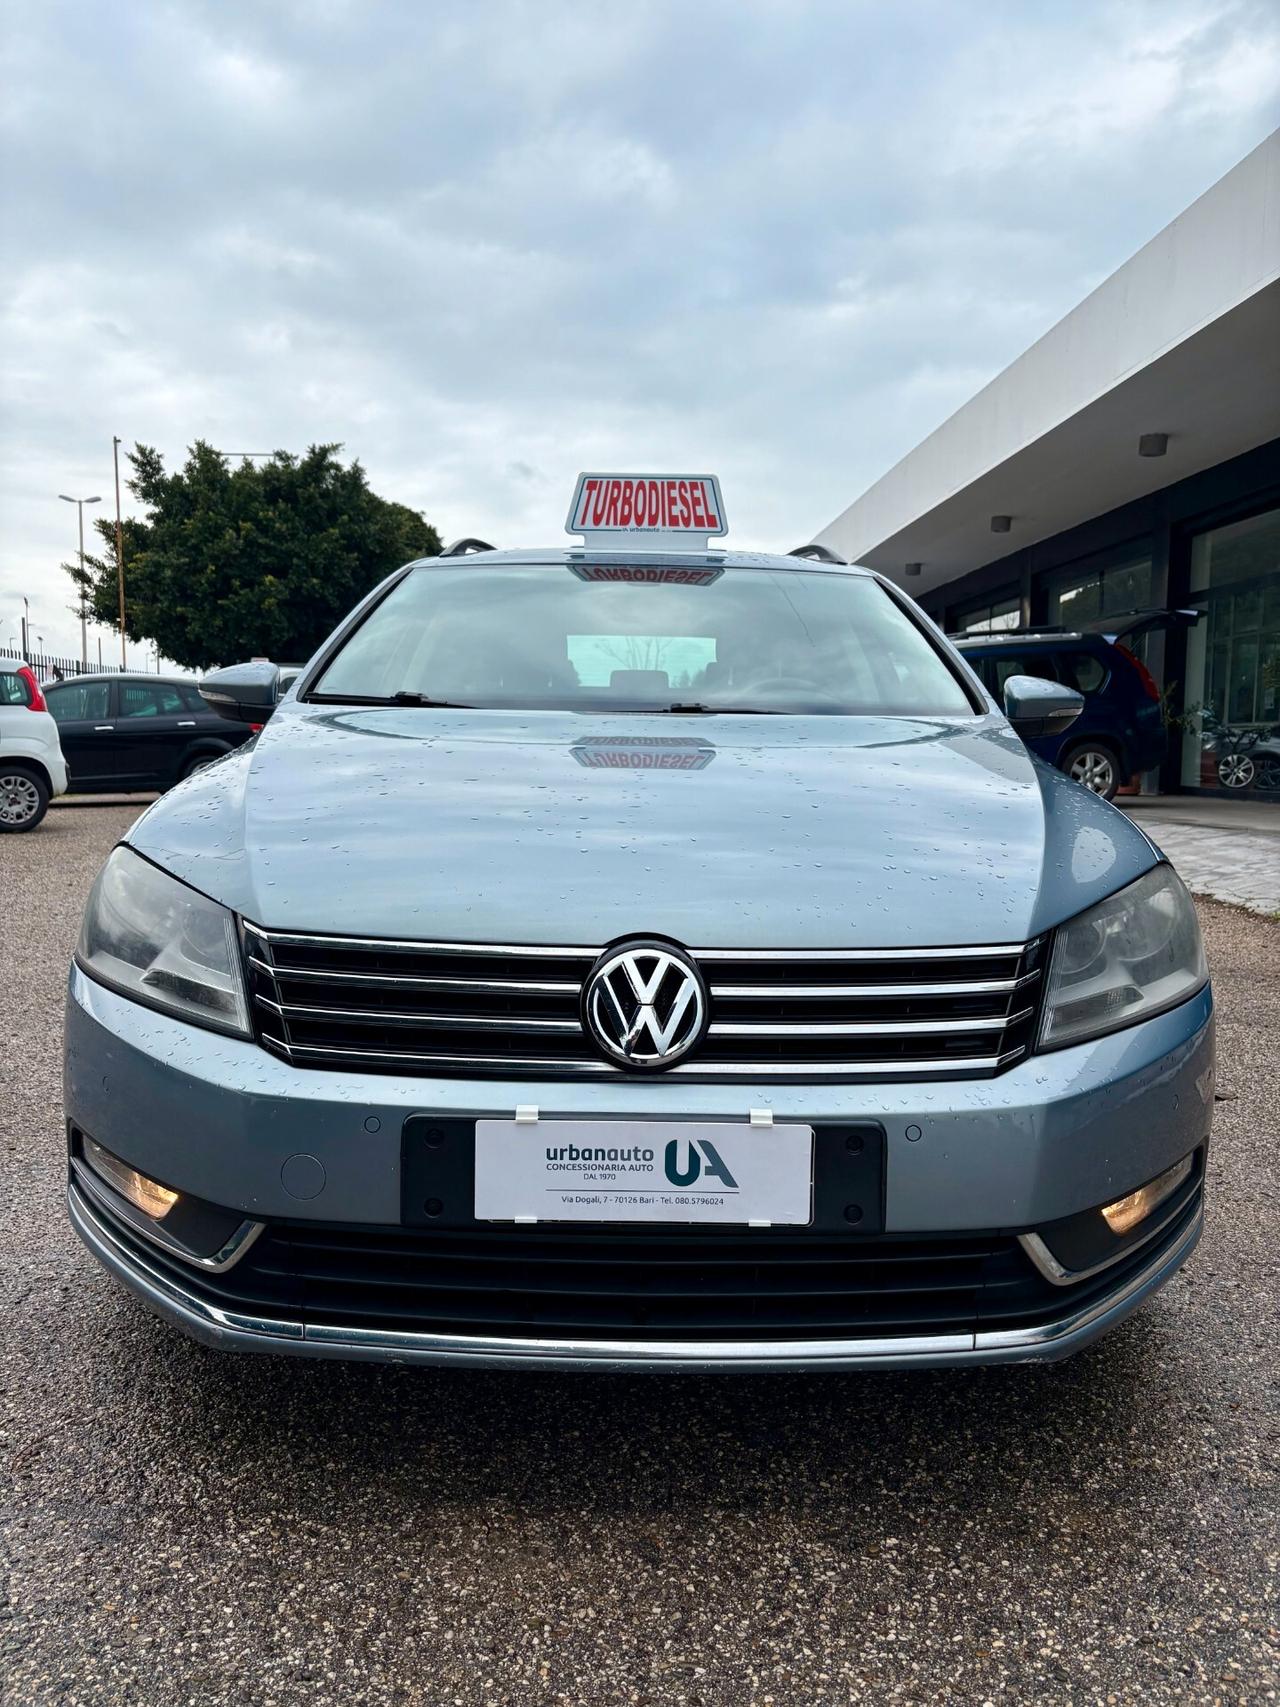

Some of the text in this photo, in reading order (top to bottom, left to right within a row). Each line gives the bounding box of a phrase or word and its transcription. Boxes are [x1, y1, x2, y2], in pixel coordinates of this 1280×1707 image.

[580, 480, 718, 528] TURBODIESEL
[546, 1144, 654, 1161] urbanauto
[546, 1163, 654, 1172] CONCESSIONARIA AUTO
[664, 1139, 739, 1188] UA
[600, 1173, 616, 1181] 1970
[561, 1196, 574, 1204] Via
[575, 1195, 602, 1205] Dogali,
[603, 1196, 608, 1204] 7
[614, 1196, 638, 1204] 70126
[639, 1196, 654, 1204] Bari
[660, 1197, 674, 1205] Tel.
[675, 1197, 724, 1205] 080.5796024
